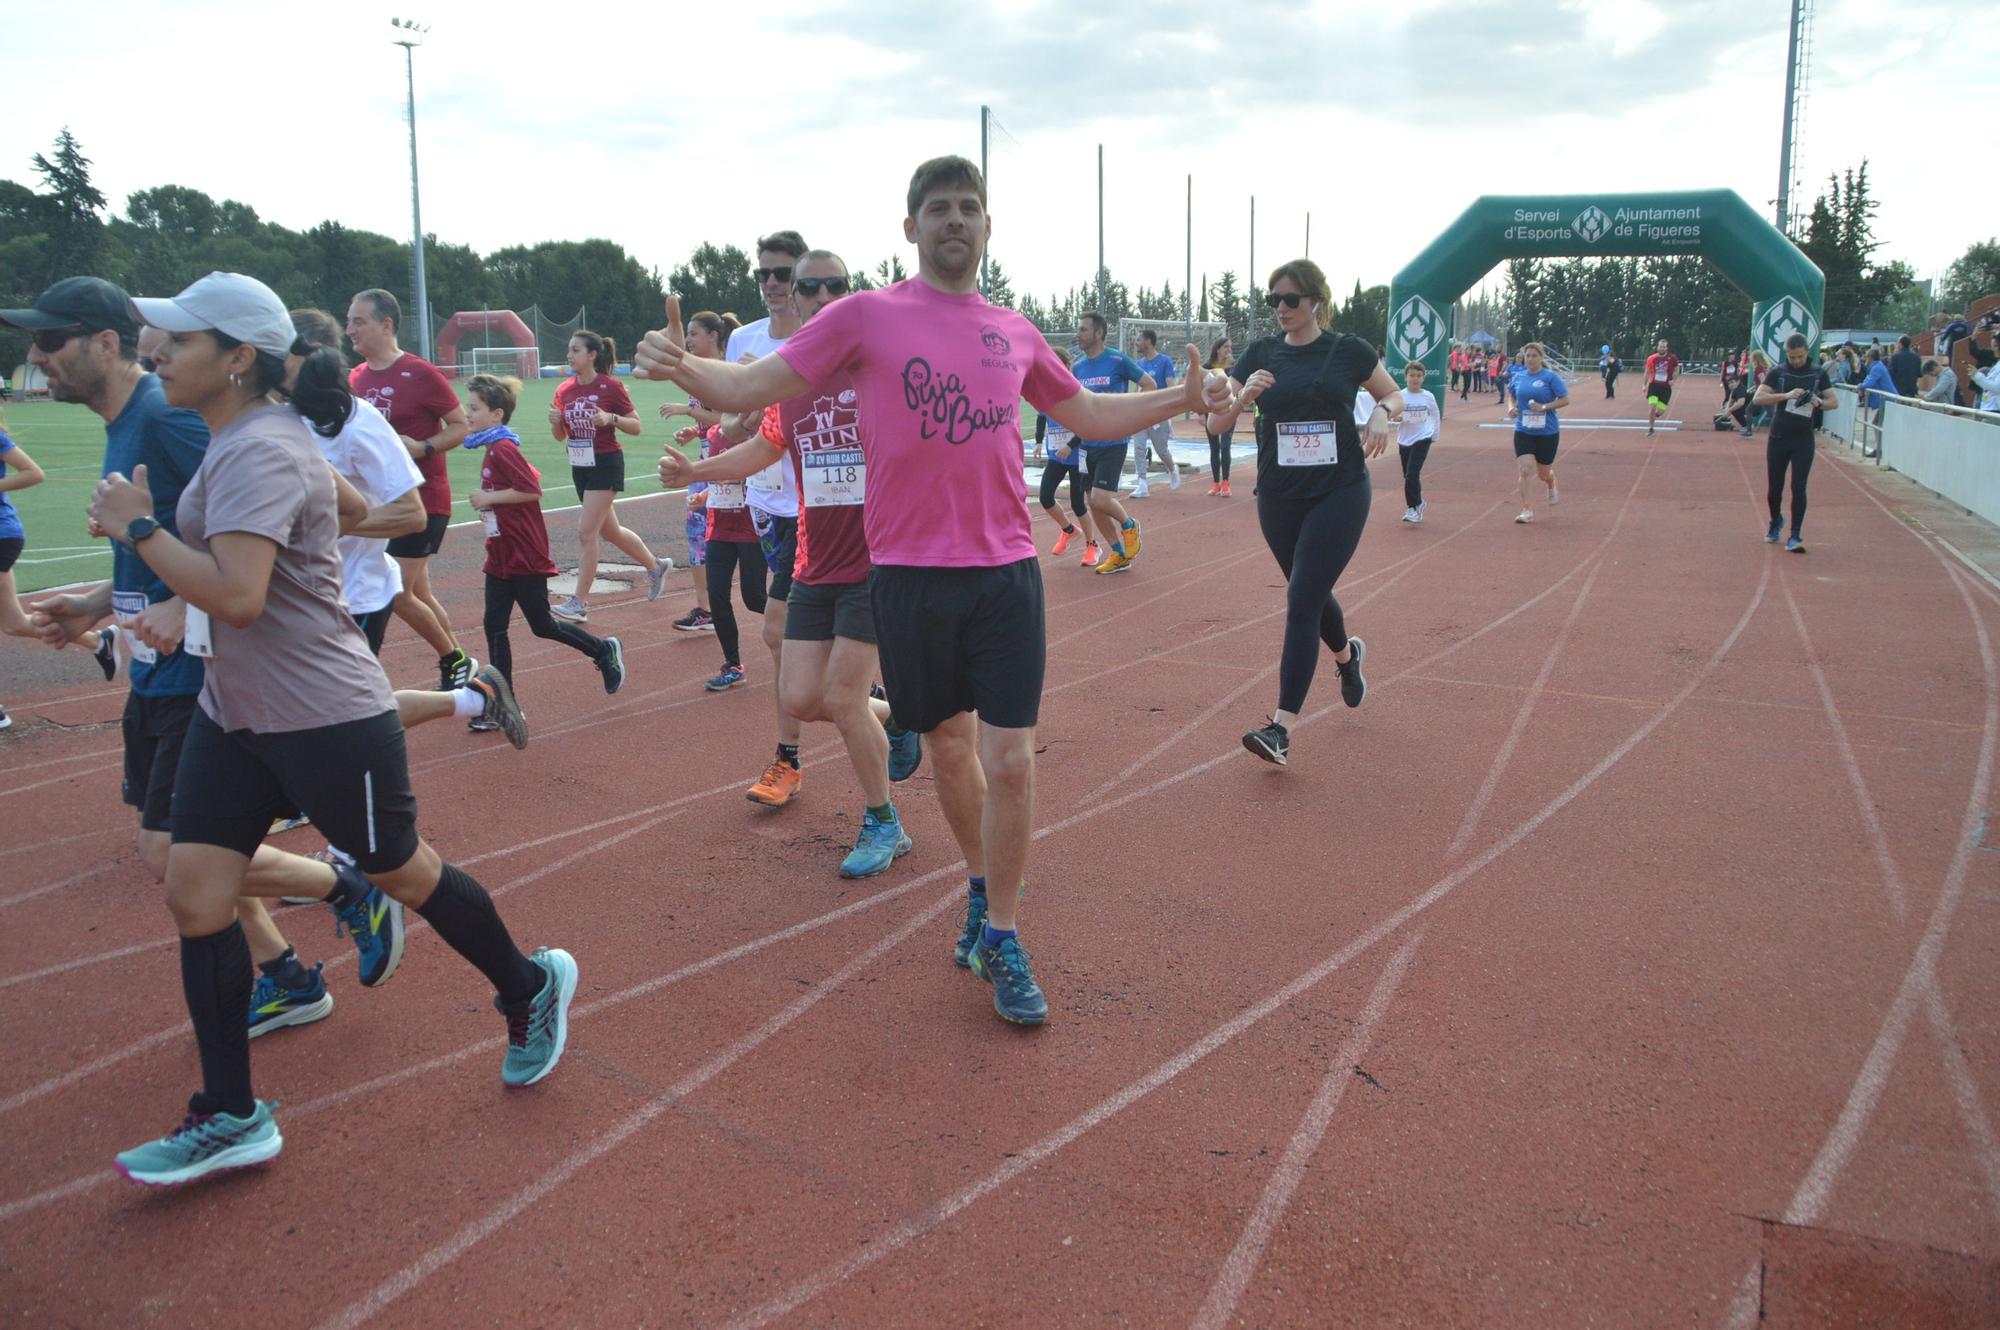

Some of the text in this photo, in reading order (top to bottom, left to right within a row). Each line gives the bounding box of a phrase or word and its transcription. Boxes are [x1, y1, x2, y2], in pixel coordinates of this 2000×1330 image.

[1514, 208, 1560, 222] Servei
[1614, 206, 1701, 223] Ajuntament
[1504, 226, 1572, 241] d'Esports
[1614, 223, 1700, 240] de Figueres
[901, 357, 966, 423] Puja
[574, 402, 585, 411] XV
[815, 410, 835, 431] XV
[921, 395, 1013, 445] i Baixa
[799, 427, 858, 451] RUN
[1293, 435, 1321, 449] 323
[816, 455, 826, 465] XV
[826, 454, 841, 464] RUN
[822, 466, 857, 484] 118
